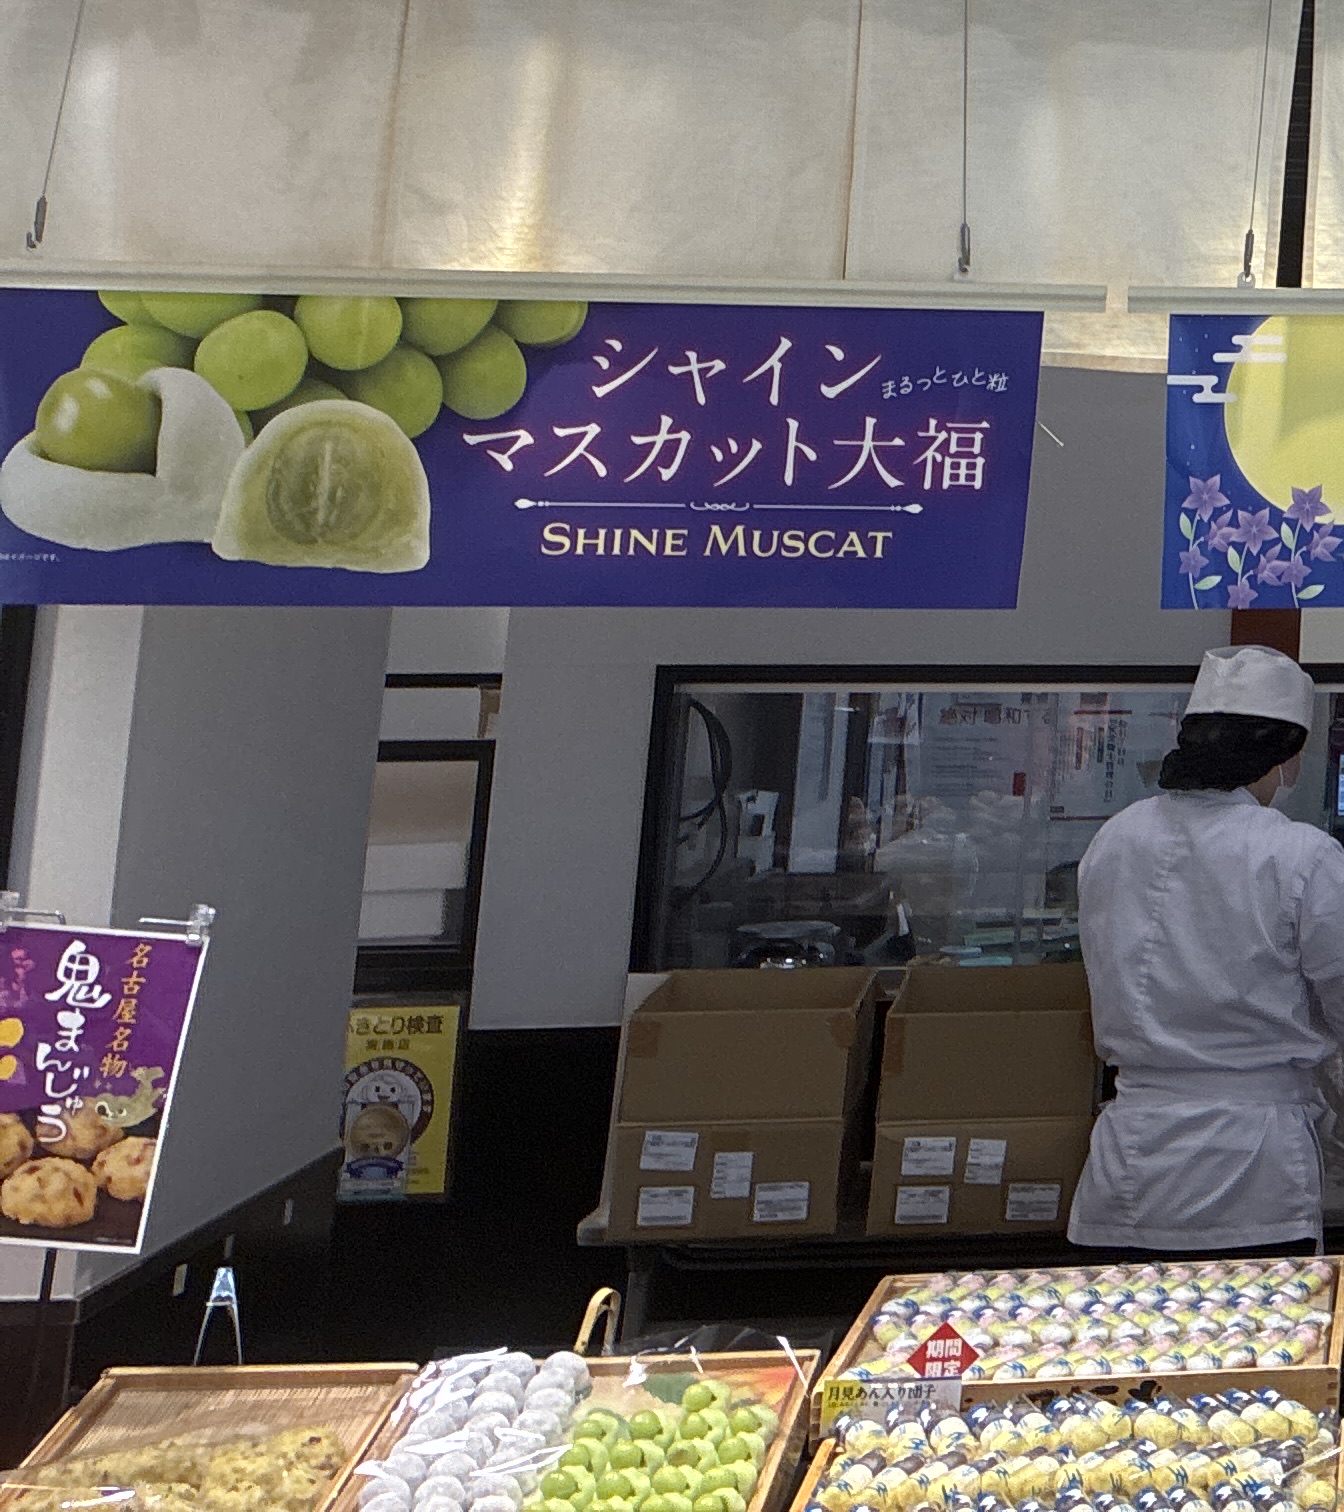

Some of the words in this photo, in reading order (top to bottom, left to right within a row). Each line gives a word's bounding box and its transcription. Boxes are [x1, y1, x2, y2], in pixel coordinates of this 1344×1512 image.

[593, 336, 884, 407] シャイン
[881, 365, 1010, 400] まるっとひと粒
[461, 416, 992, 494] マスカット大福
[540, 520, 688, 559] SHINE
[703, 523, 894, 561] MUSCAT
[35, 940, 112, 1143] 鬼まんじゅう
[98, 942, 153, 1079] 名古屋名物
[926, 1337, 963, 1358] 期間
